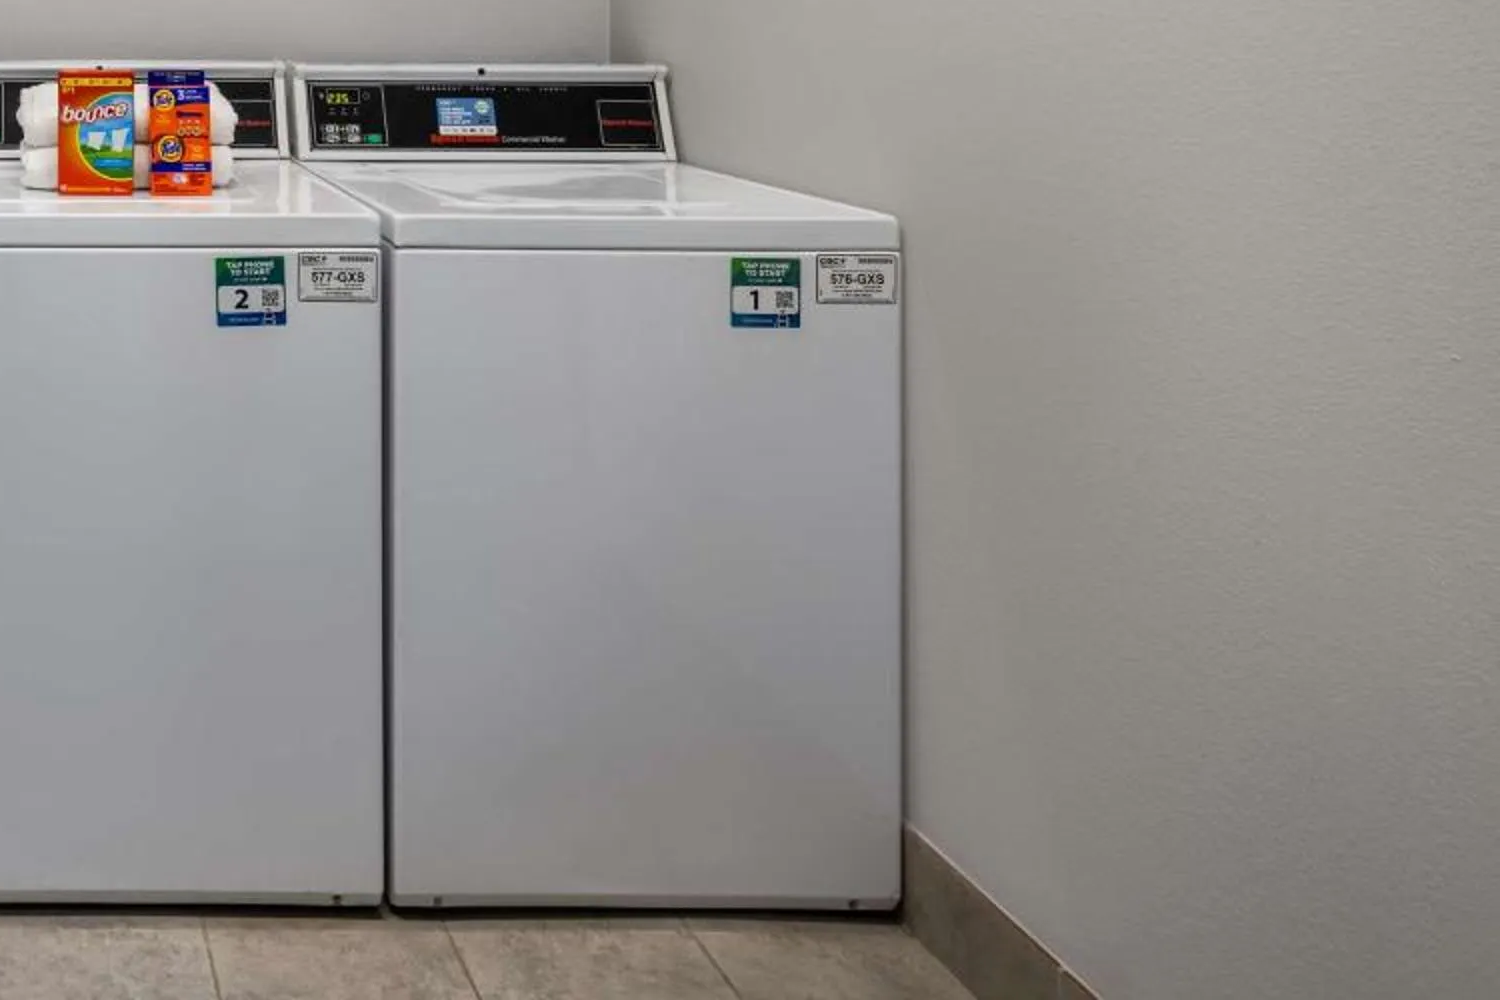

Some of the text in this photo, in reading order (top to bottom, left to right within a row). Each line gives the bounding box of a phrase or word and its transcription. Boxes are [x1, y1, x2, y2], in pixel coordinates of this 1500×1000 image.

[62, 103, 127, 123] bounce
[234, 289, 249, 309] 2
[749, 289, 759, 310] 1
